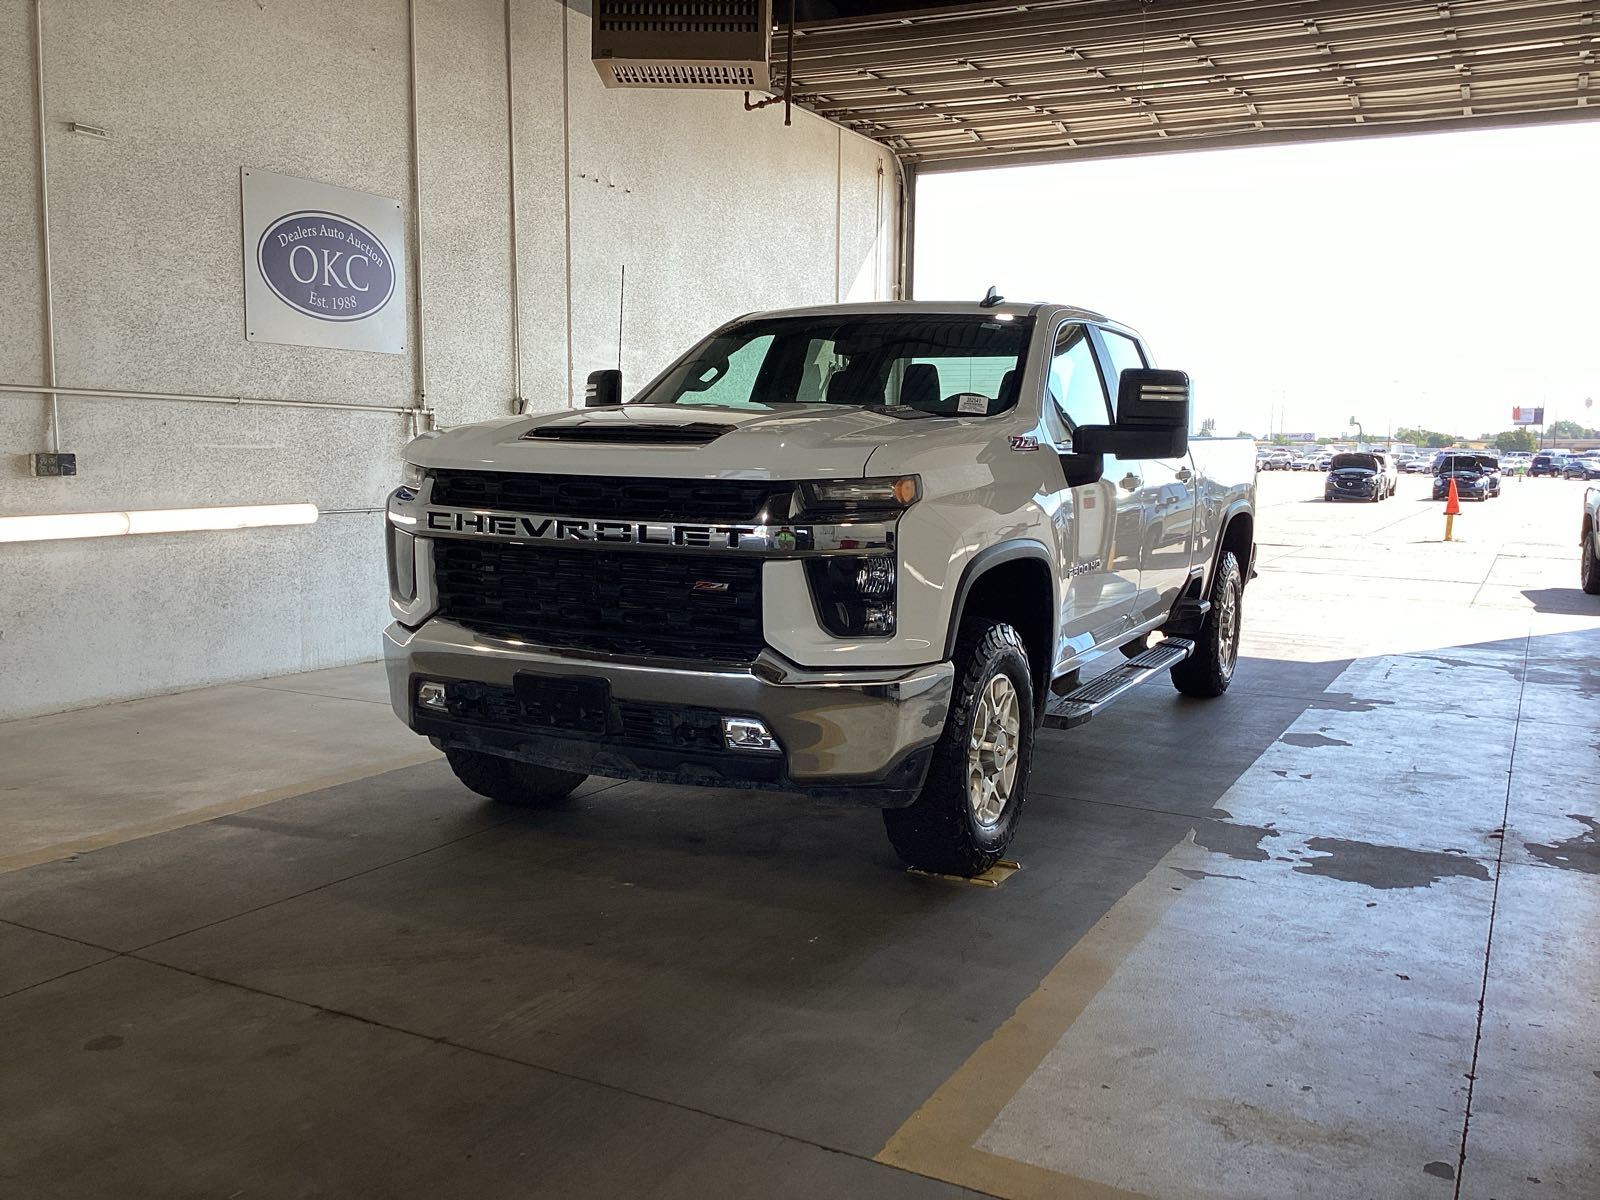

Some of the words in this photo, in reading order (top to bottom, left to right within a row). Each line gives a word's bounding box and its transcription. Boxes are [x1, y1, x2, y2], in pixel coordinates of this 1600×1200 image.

[277, 226, 318, 248] Dealers
[319, 224, 345, 240] Auto
[346, 232, 384, 268] Auction
[289, 245, 370, 292] OKC
[308, 291, 329, 309] Est.
[331, 295, 358, 311] 1988
[426, 511, 754, 549] CHEVROLET
